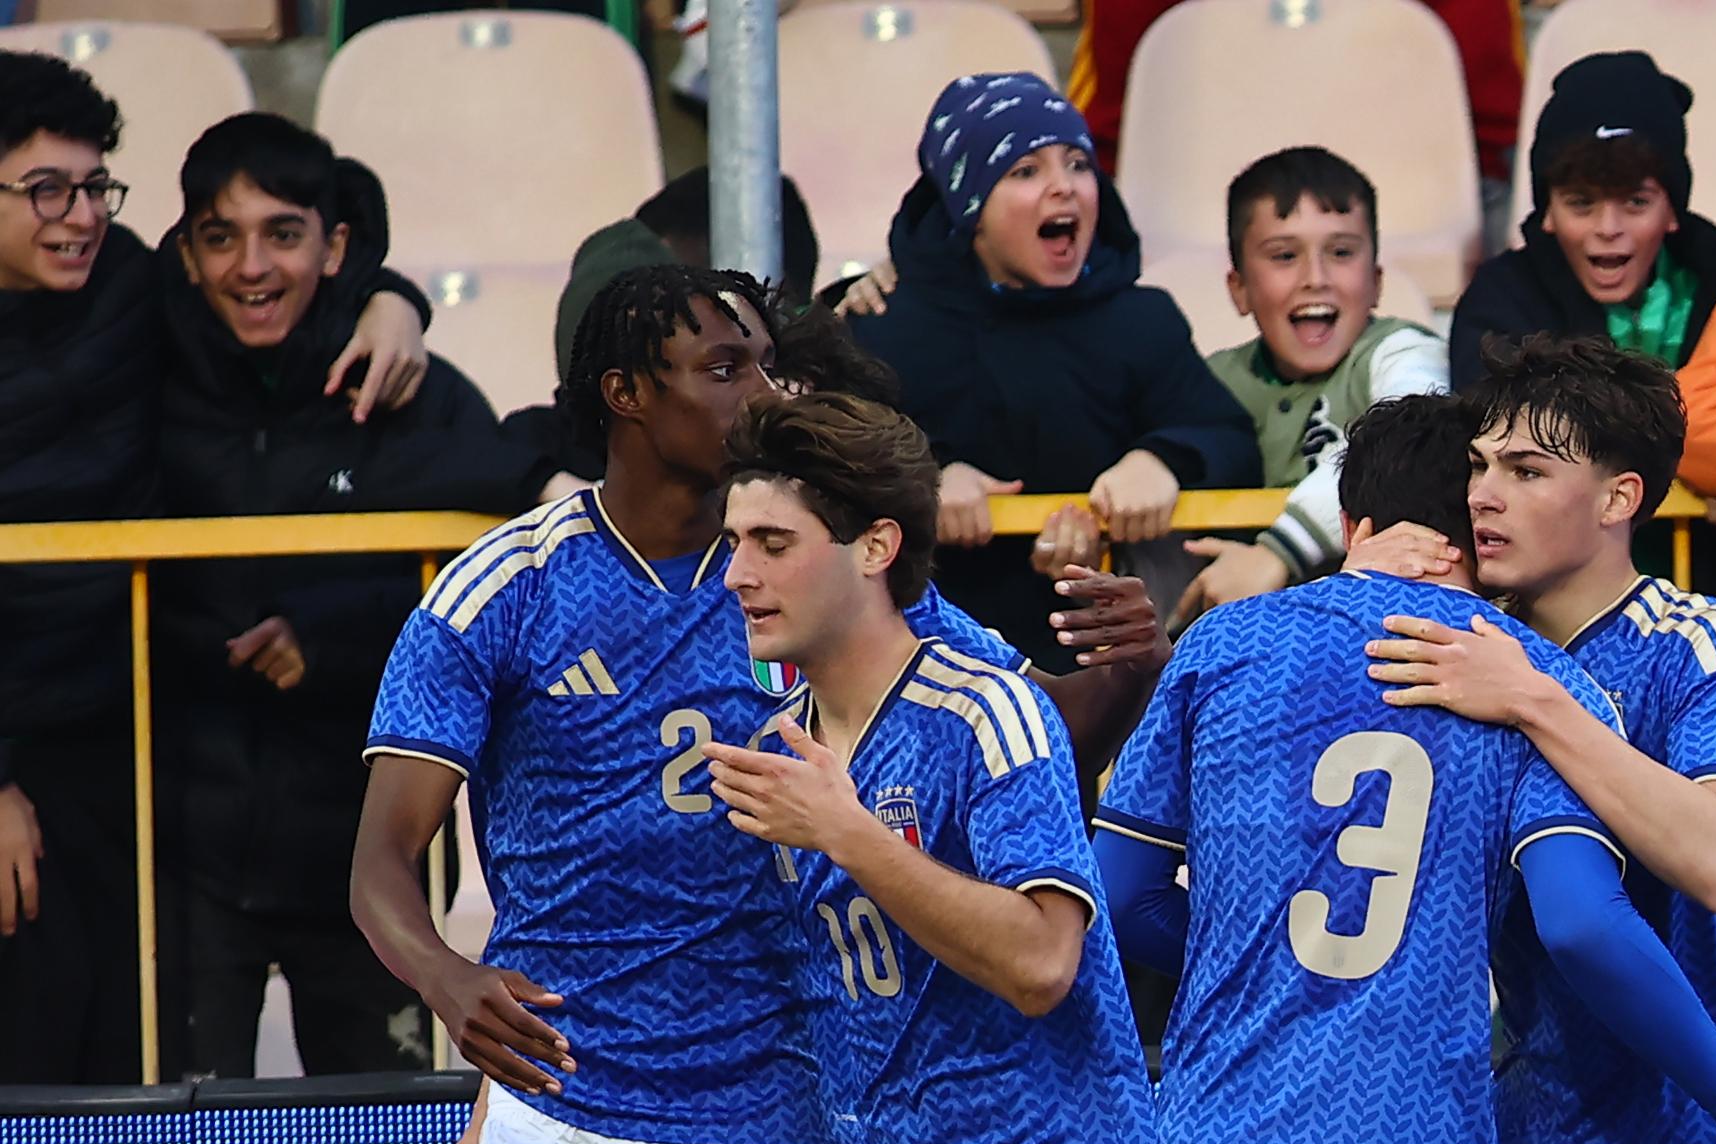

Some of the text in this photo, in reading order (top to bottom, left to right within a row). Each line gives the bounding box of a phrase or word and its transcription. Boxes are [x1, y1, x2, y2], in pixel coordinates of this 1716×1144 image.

[660, 708, 713, 813] 2
[878, 805, 914, 823] ITALIA
[1288, 731, 1434, 980] 3
[816, 896, 901, 1002] 10
